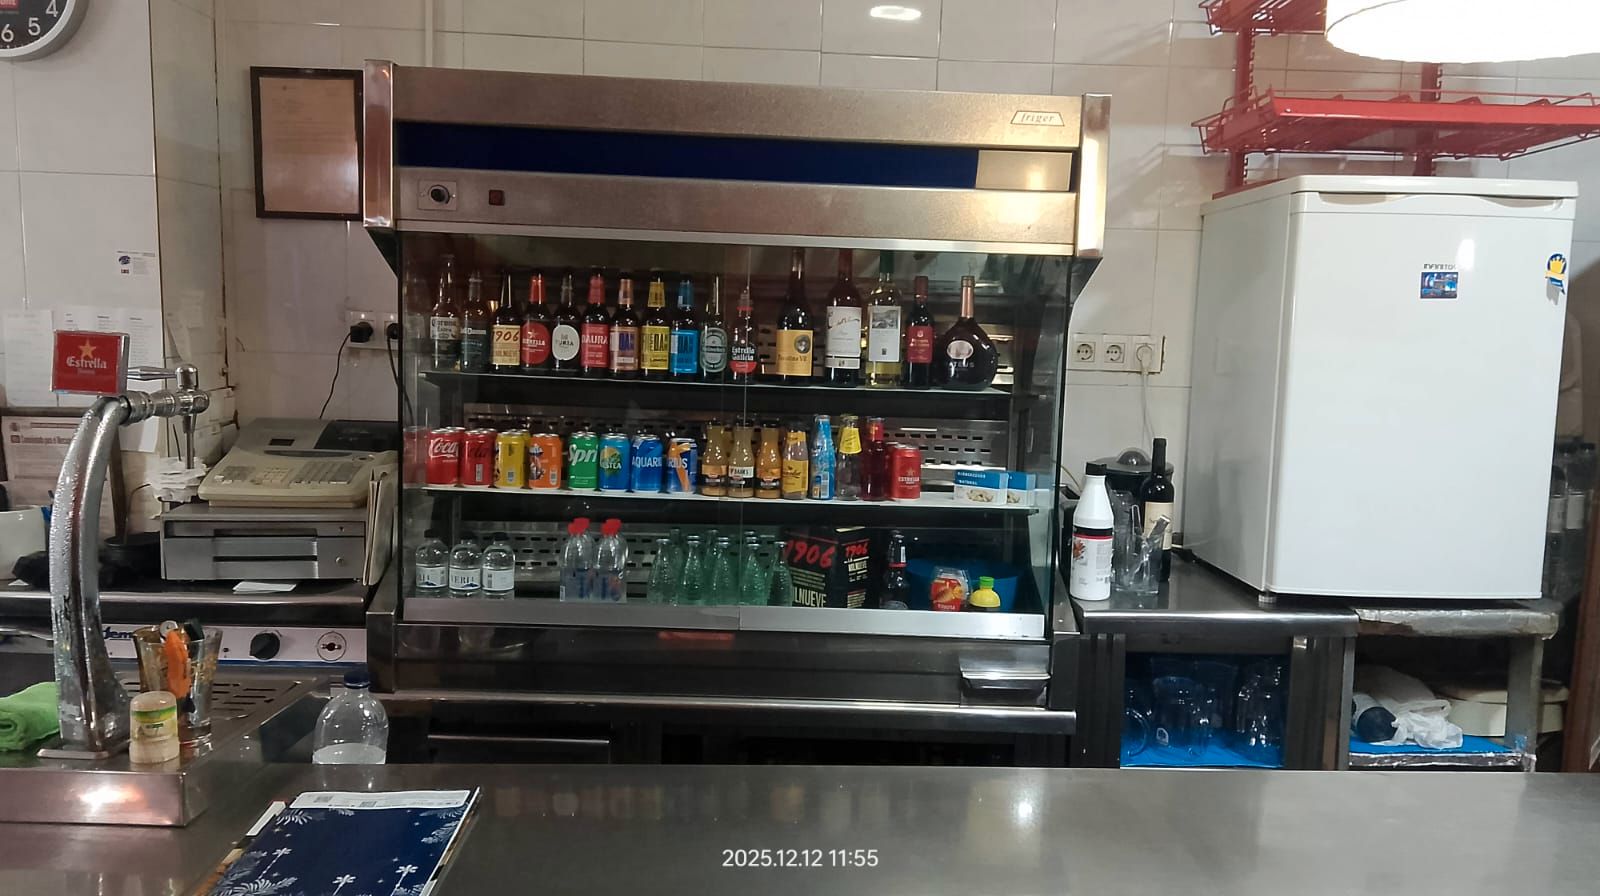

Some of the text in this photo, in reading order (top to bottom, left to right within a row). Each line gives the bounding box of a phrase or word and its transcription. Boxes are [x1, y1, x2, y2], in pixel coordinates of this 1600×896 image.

[45, 0, 59, 17] 4
[1, 23, 14, 42] 6
[27, 17, 41, 36] 5
[581, 334, 609, 345] DAURA
[66, 355, 107, 369] Estrella
[784, 540, 836, 569] 1906
[845, 542, 869, 557] 1906
